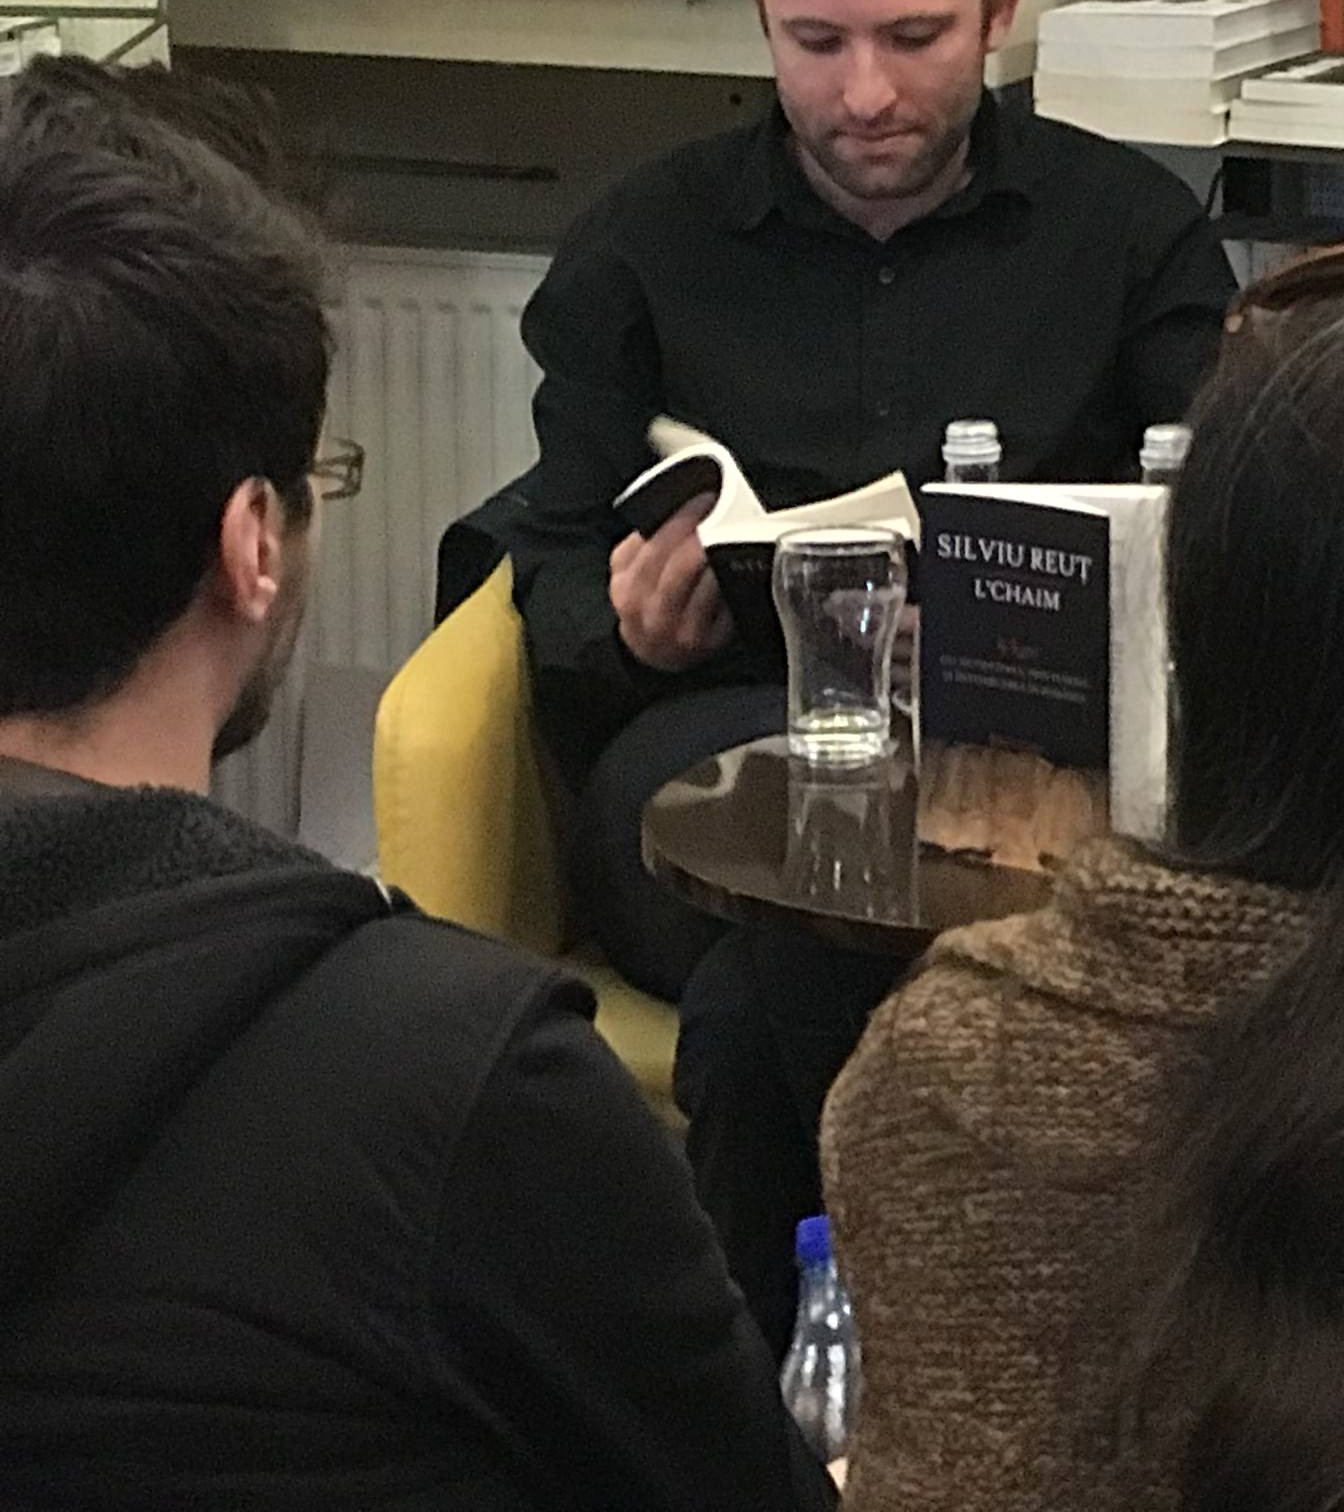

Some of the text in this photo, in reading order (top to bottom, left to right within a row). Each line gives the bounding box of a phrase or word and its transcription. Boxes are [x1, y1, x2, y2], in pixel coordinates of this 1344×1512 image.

[937, 533, 1092, 583] SILVIU REUT
[975, 579, 1060, 611] L'CHAIM
